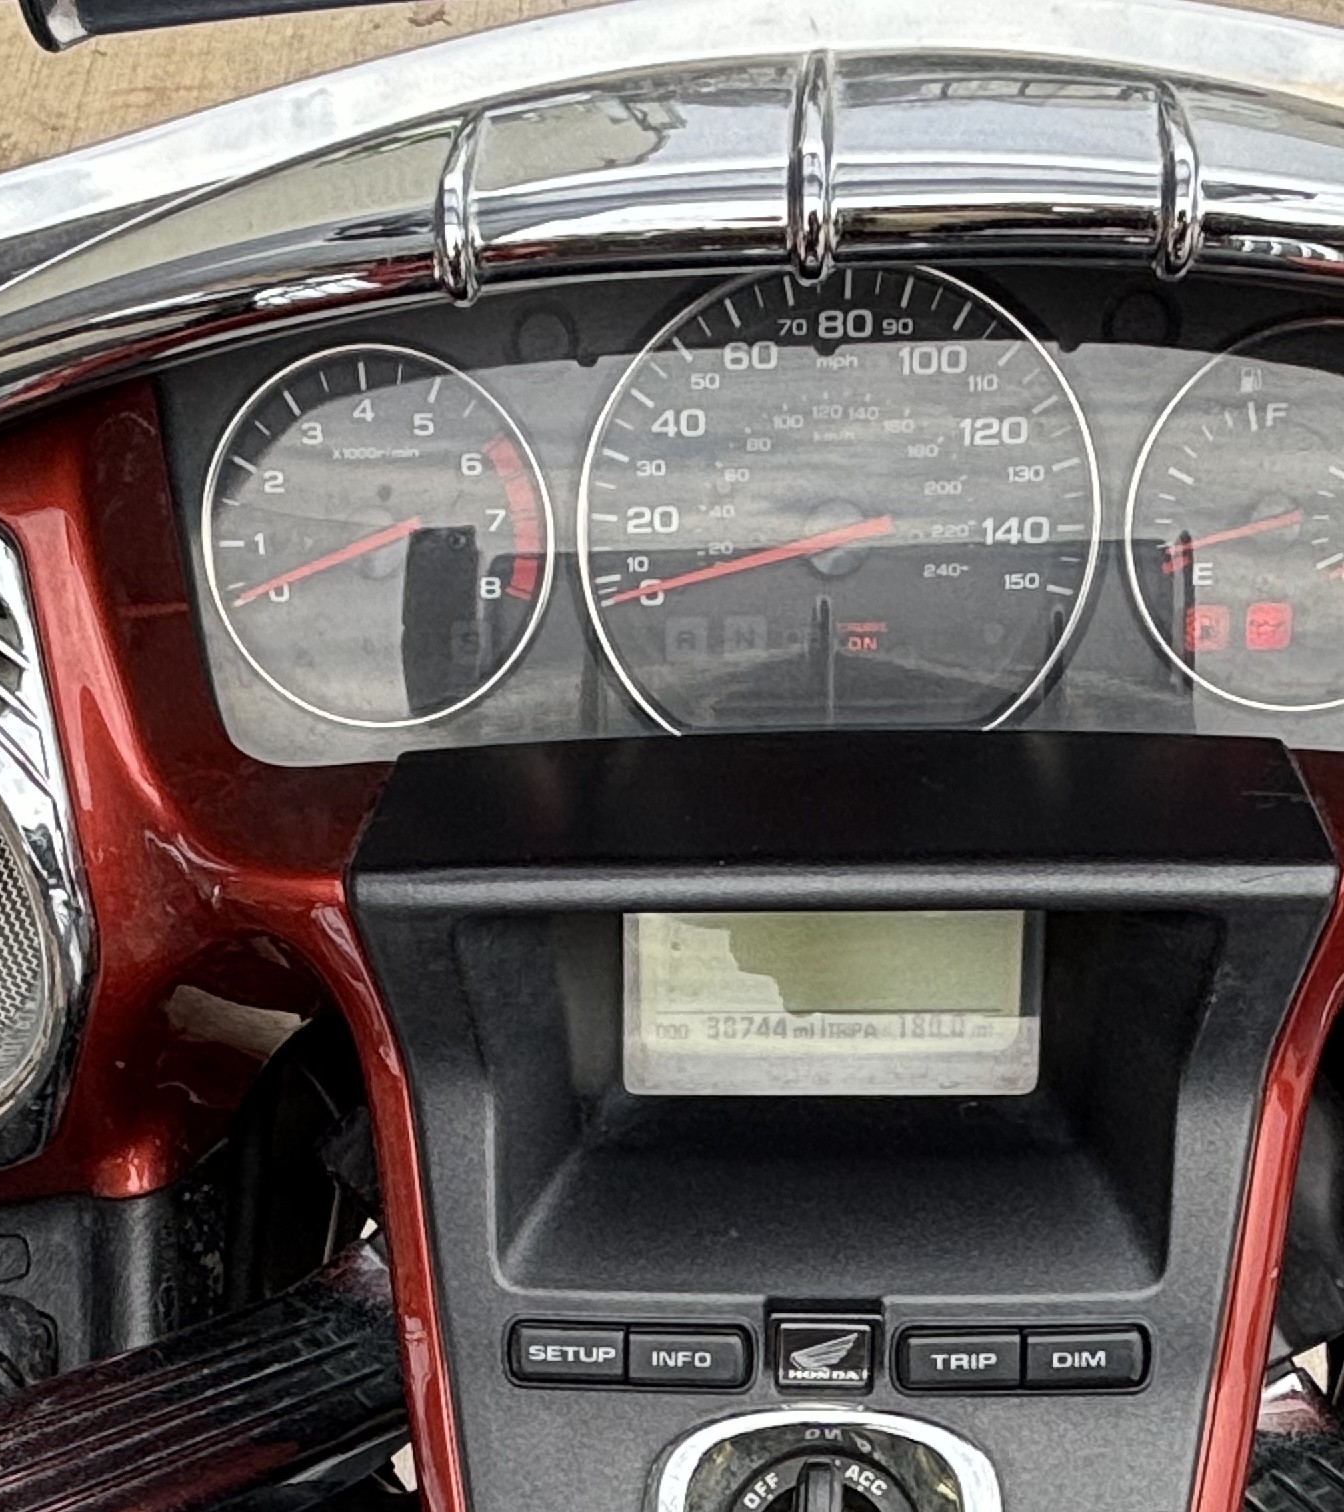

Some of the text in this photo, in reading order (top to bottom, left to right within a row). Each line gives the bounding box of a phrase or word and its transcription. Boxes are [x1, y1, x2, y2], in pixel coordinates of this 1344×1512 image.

[778, 320, 807, 335] 70
[817, 310, 872, 338] 80
[882, 320, 914, 335] 90
[723, 343, 778, 370] 60
[816, 354, 858, 370] mph
[898, 346, 968, 375] 100
[690, 373, 720, 390] 50
[968, 375, 998, 392] 110
[353, 399, 374, 421] 4
[812, 405, 843, 420] 120
[848, 406, 880, 420] 140
[1265, 403, 1289, 427] F
[413, 413, 434, 435] 5
[651, 409, 706, 438] 40
[773, 415, 804, 429] 100
[959, 417, 1028, 446] 120
[301, 422, 324, 444] 3
[461, 454, 482, 475] 6
[636, 460, 666, 476] 30
[1007, 466, 1044, 482] 130
[263, 472, 285, 494] 2
[924, 481, 962, 496] 200
[485, 509, 506, 531] 7
[626, 507, 679, 533] 20
[708, 505, 735, 519] 40
[931, 524, 970, 538] 220
[981, 516, 1050, 544] 140
[255, 533, 265, 555] 1
[708, 541, 734, 555] 20
[627, 556, 648, 573] 10
[922, 563, 959, 578] 240
[1193, 563, 1214, 586] E
[480, 577, 501, 599] 8
[1004, 574, 1039, 589] 150
[639, 579, 664, 605] 0
[849, 636, 877, 650] ON
[528, 1344, 616, 1364] SETUP
[651, 1350, 712, 1369] INFO
[931, 1353, 998, 1371] TRIP
[1052, 1350, 1107, 1371] DIM
[788, 1370, 860, 1380] HONDA
[844, 1465, 888, 1496] ACC
[743, 1472, 779, 1510] OFF
